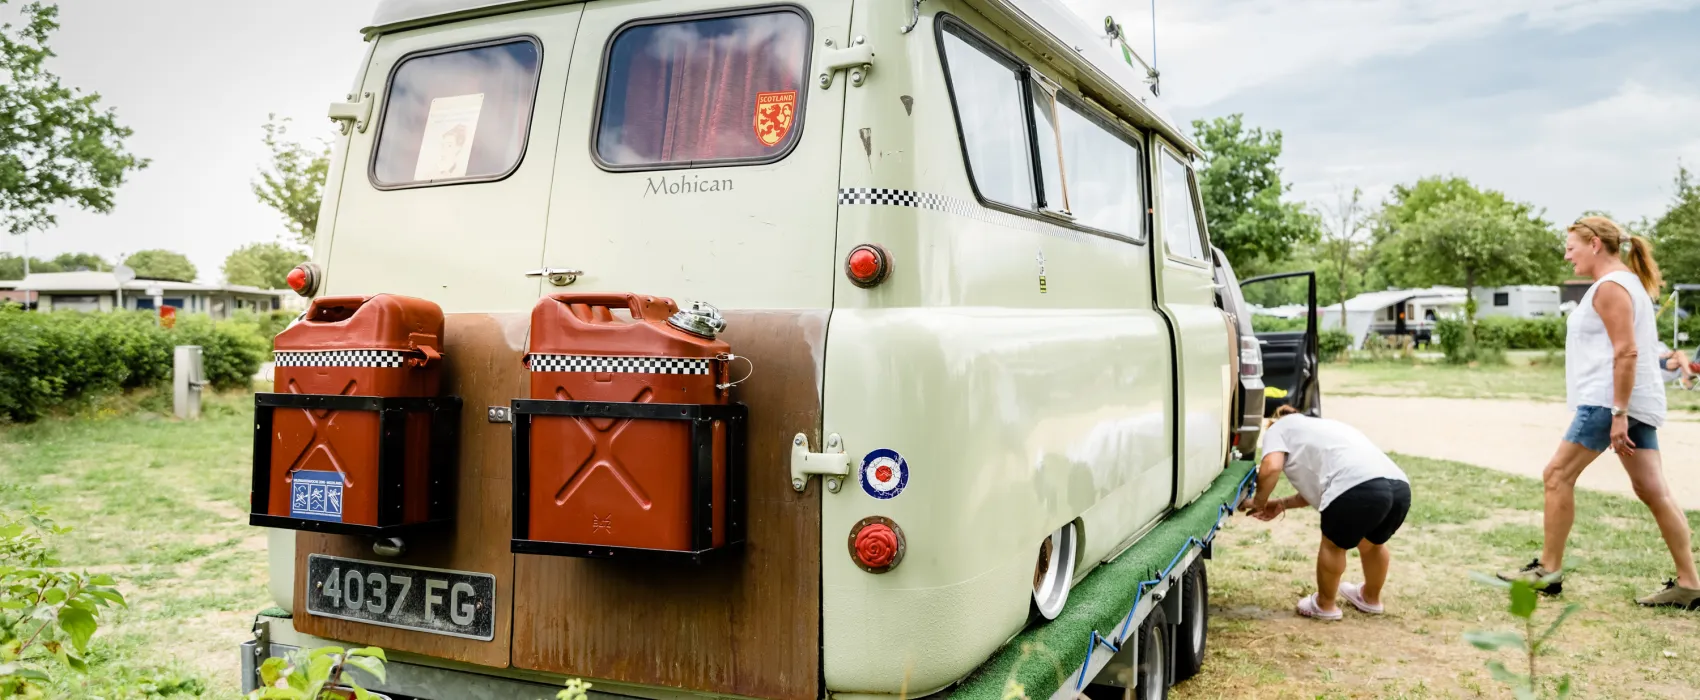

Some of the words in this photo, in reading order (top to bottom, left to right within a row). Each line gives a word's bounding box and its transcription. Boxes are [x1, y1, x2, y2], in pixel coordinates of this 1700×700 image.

[759, 94, 793, 103] SCOTLAND
[643, 174, 734, 199] Mohican
[322, 567, 412, 619] 4037
[424, 578, 475, 626] FG
